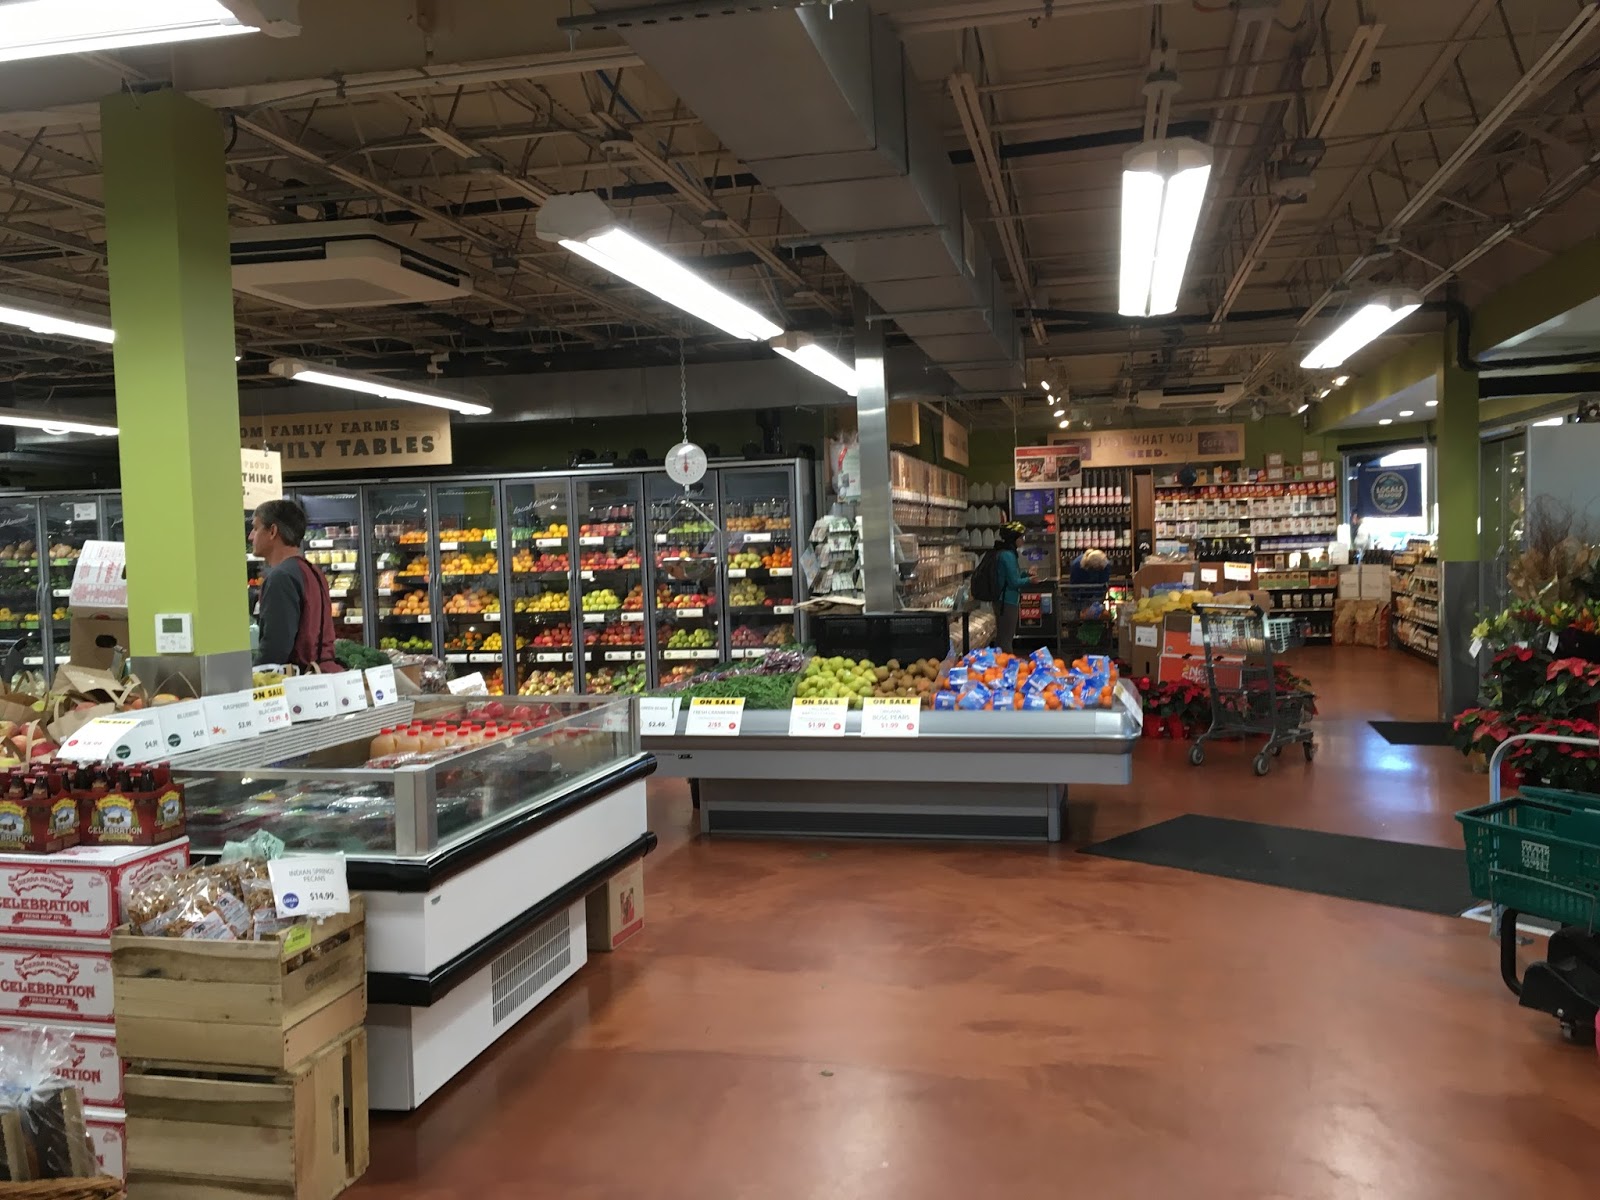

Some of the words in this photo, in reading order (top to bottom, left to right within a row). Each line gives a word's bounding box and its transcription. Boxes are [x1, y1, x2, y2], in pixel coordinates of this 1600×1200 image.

[240, 426, 263, 438] OM
[270, 423, 333, 437] FAMILY
[341, 420, 400, 434] FARMS
[1134, 433, 1164, 446] WHAT
[1170, 433, 1193, 444] YOU
[336, 435, 435, 457] TABLES
[242, 472, 273, 484] THING
[253, 690, 265, 700] ON
[267, 688, 283, 696] SALE
[87, 826, 143, 835] CELEBRATION
[0, 834, 35, 844] BRATION
[288, 869, 312, 877] INDIAN
[312, 868, 335, 876] SPRINGS
[16, 876, 40, 886] SIERRA
[40, 876, 65, 888] NEVADA
[309, 891, 335, 901] $14.99
[23, 961, 45, 970] SIERRA
[45, 960, 71, 973] NEVADA
[0, 979, 96, 999] CELEBRATION
